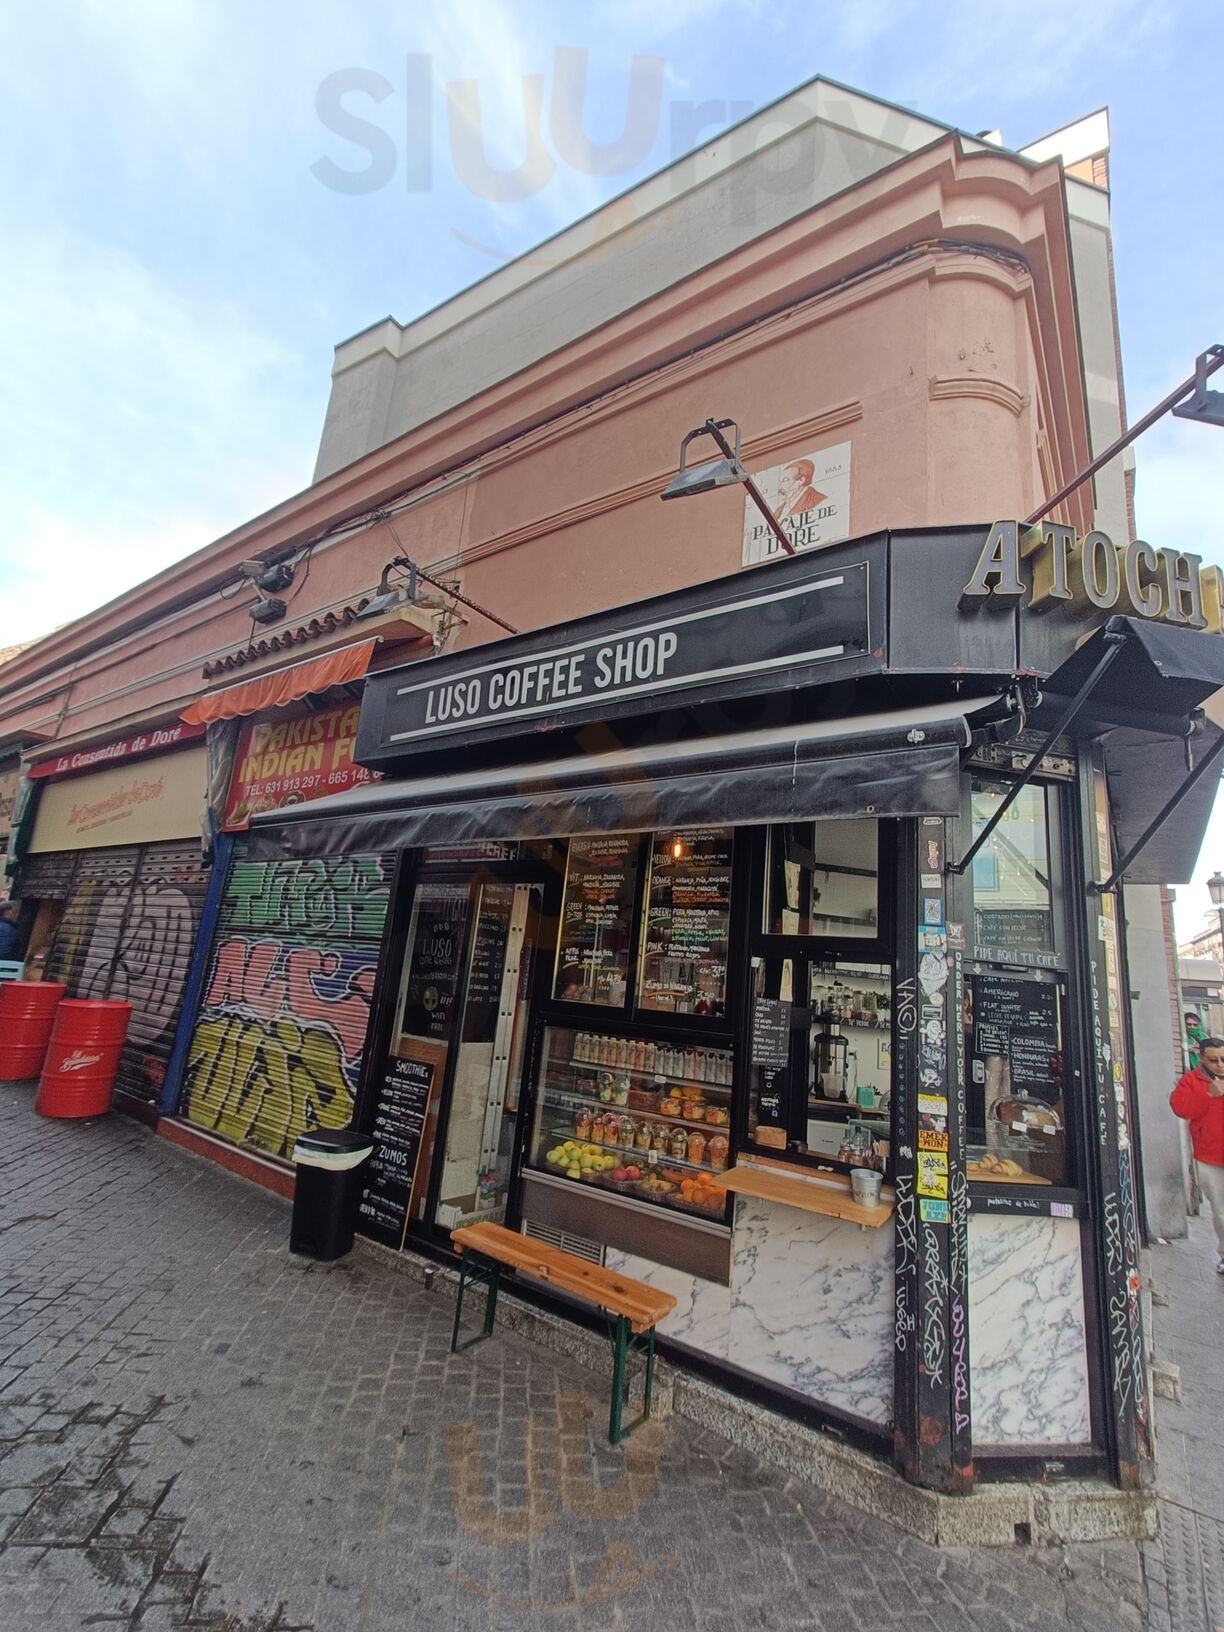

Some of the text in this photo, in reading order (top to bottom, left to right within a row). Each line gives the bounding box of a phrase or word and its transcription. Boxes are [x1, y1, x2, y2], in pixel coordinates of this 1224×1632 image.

[817, 504, 838, 520] DE
[961, 519, 1224, 635] ATOCH
[424, 631, 678, 725] LUSO COFFEE SHOP
[56, 758, 68, 772] La
[131, 736, 146, 752] de
[239, 742, 325, 783] INDIAN
[265, 781, 281, 794] 631
[283, 778, 300, 791] 913
[301, 775, 321, 788] 297
[328, 771, 348, 785] 665
[973, 945, 993, 960] PIDE
[1020, 953, 1035, 964] TU
[1036, 952, 1061, 967] CAFÉ
[1091, 960, 1100, 1010] PIDE
[1097, 1065, 1105, 1084] TU
[954, 951, 966, 1161] ORDER HERE YOUR COFFEE
[1012, 1037, 1046, 1047] COLOMBIA
[1013, 1051, 1046, 1062] HONDURAS
[379, 1145, 408, 1166] ZUMOS
